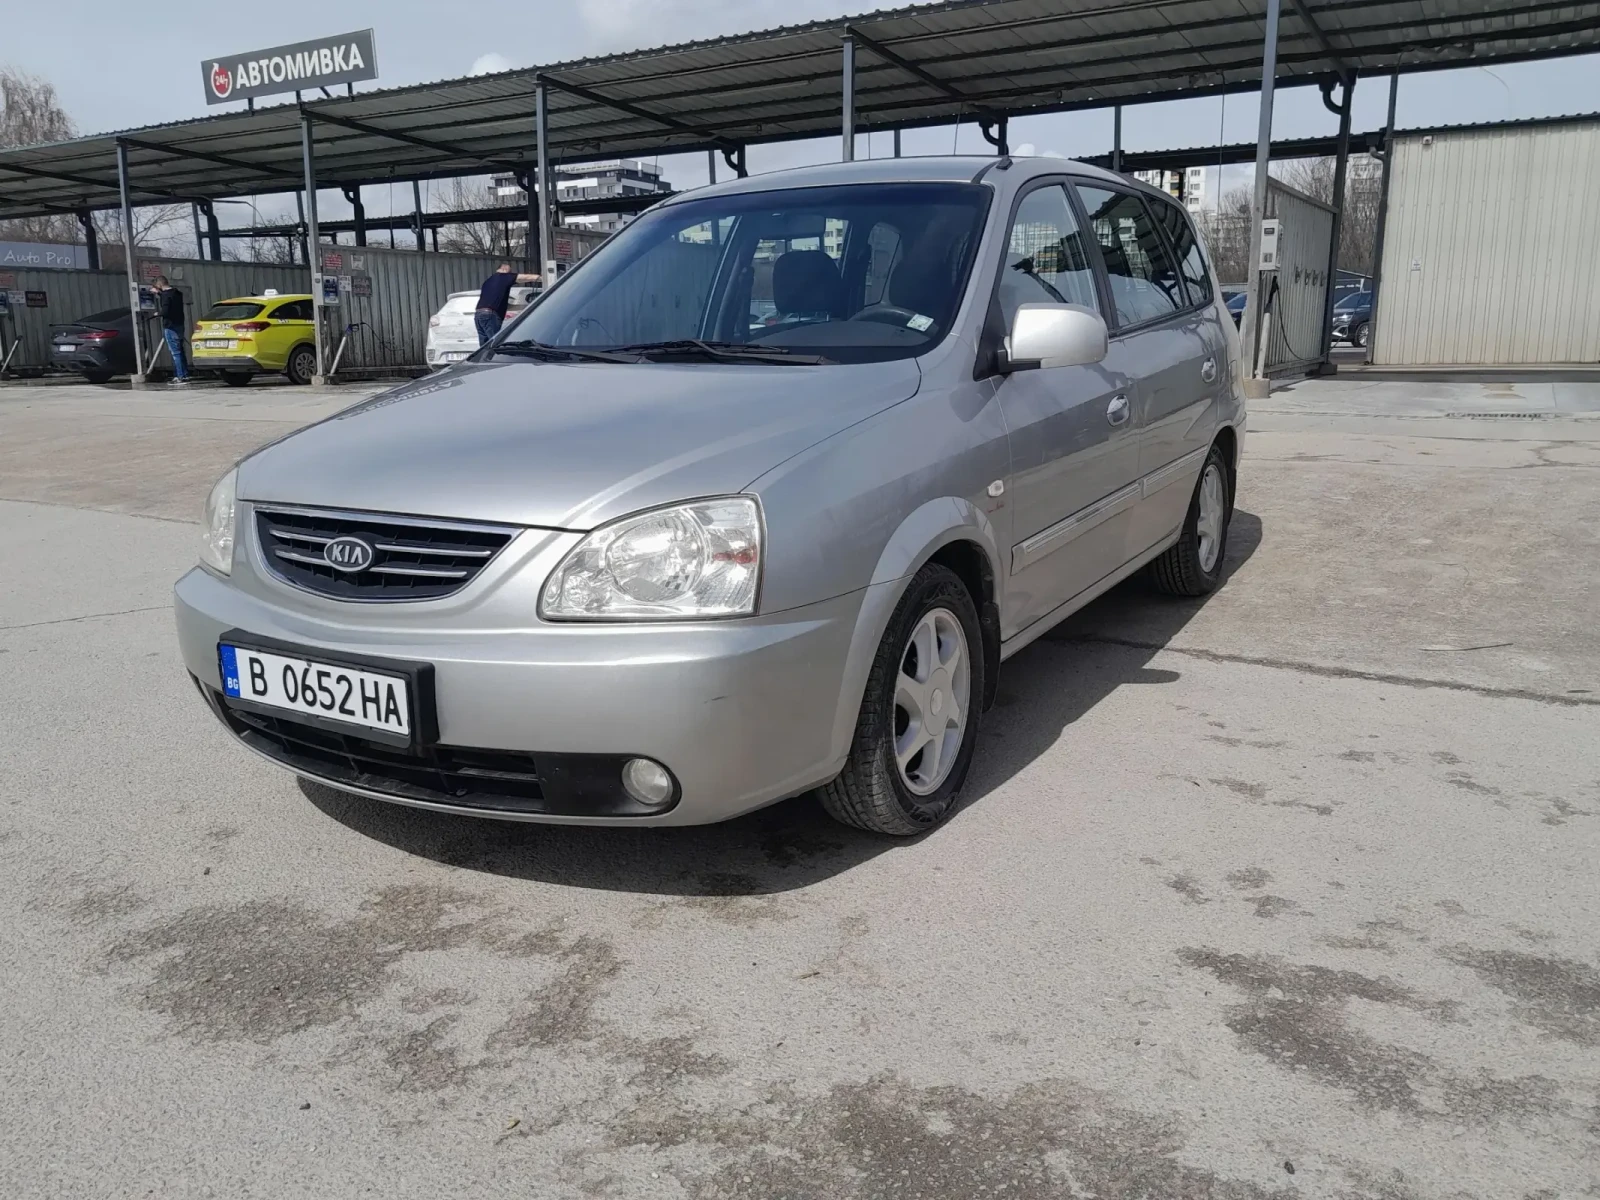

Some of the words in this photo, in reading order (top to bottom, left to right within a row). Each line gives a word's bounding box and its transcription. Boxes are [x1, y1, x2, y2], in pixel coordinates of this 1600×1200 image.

[236, 43, 365, 89] АВТОМИВКА
[4, 250, 40, 264] Auto
[46, 252, 71, 265] Pro
[332, 544, 363, 564] KIA
[227, 677, 239, 690] BG
[249, 657, 268, 697] B
[283, 664, 403, 727] 0652HA
